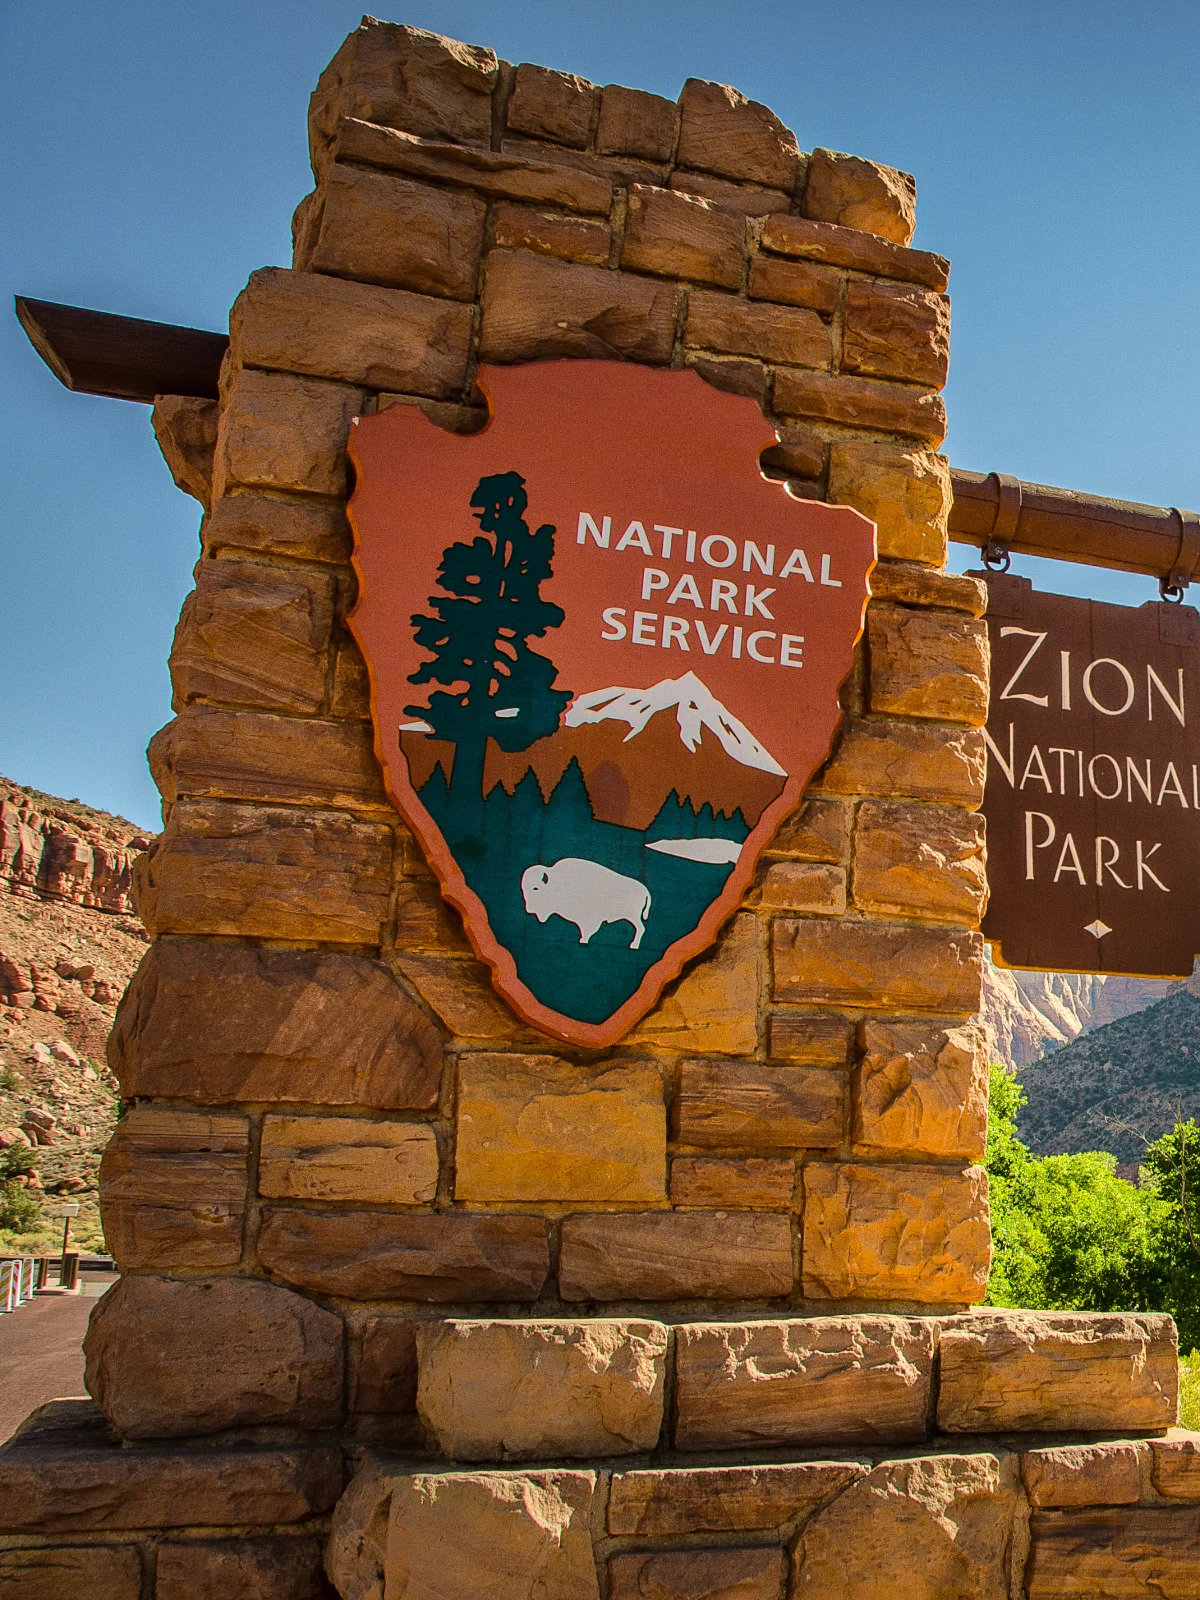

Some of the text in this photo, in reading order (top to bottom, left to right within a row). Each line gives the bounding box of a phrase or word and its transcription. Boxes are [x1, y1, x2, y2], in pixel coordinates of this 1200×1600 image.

[577, 512, 842, 587] NATIONAL
[641, 567, 776, 620] PARK
[601, 607, 804, 668] SERVICE
[1000, 626, 1185, 727] ZION
[1025, 811, 1171, 892] PARK
